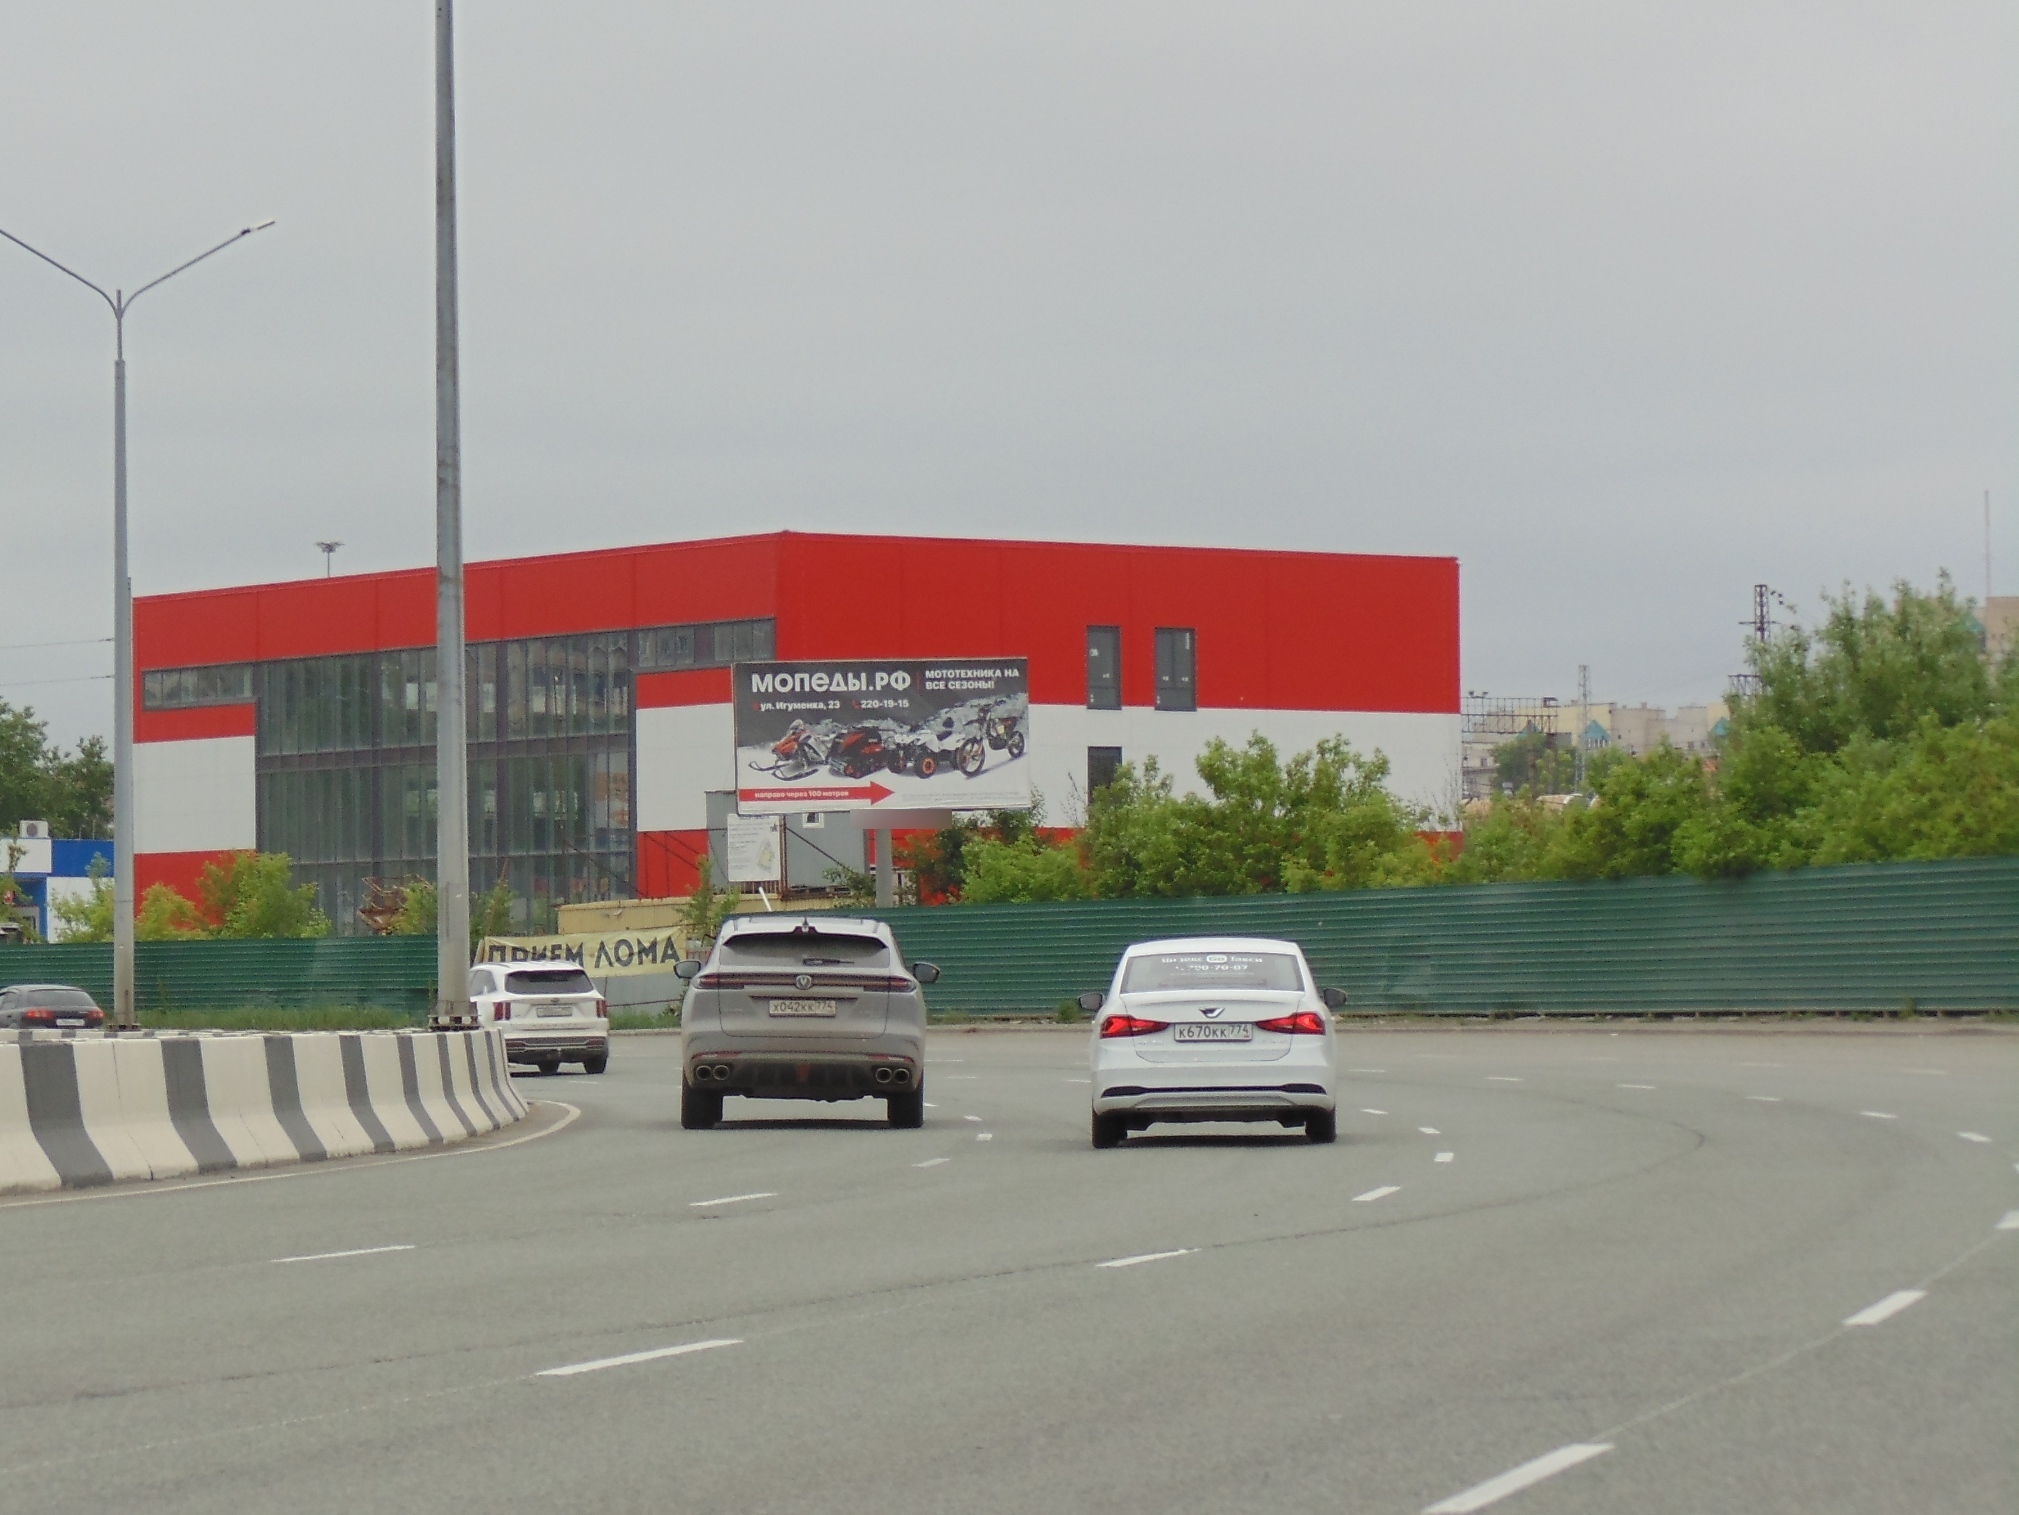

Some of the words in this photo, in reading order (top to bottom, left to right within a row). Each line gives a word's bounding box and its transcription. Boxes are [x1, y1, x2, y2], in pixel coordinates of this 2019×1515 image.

[925, 668, 1002, 679] МОТОТЕХНИКА
[1004, 668, 1020, 677] НА
[925, 681, 946, 690] ВСЕ
[948, 680, 995, 690] СЕЗОНЫ!
[760, 703, 775, 712] ул.
[776, 701, 827, 711] Игуменка,
[828, 700, 841, 709] 23
[861, 699, 910, 708] 220-19-15
[786, 791, 807, 799] через
[594, 936, 681, 968] ЛОМА
